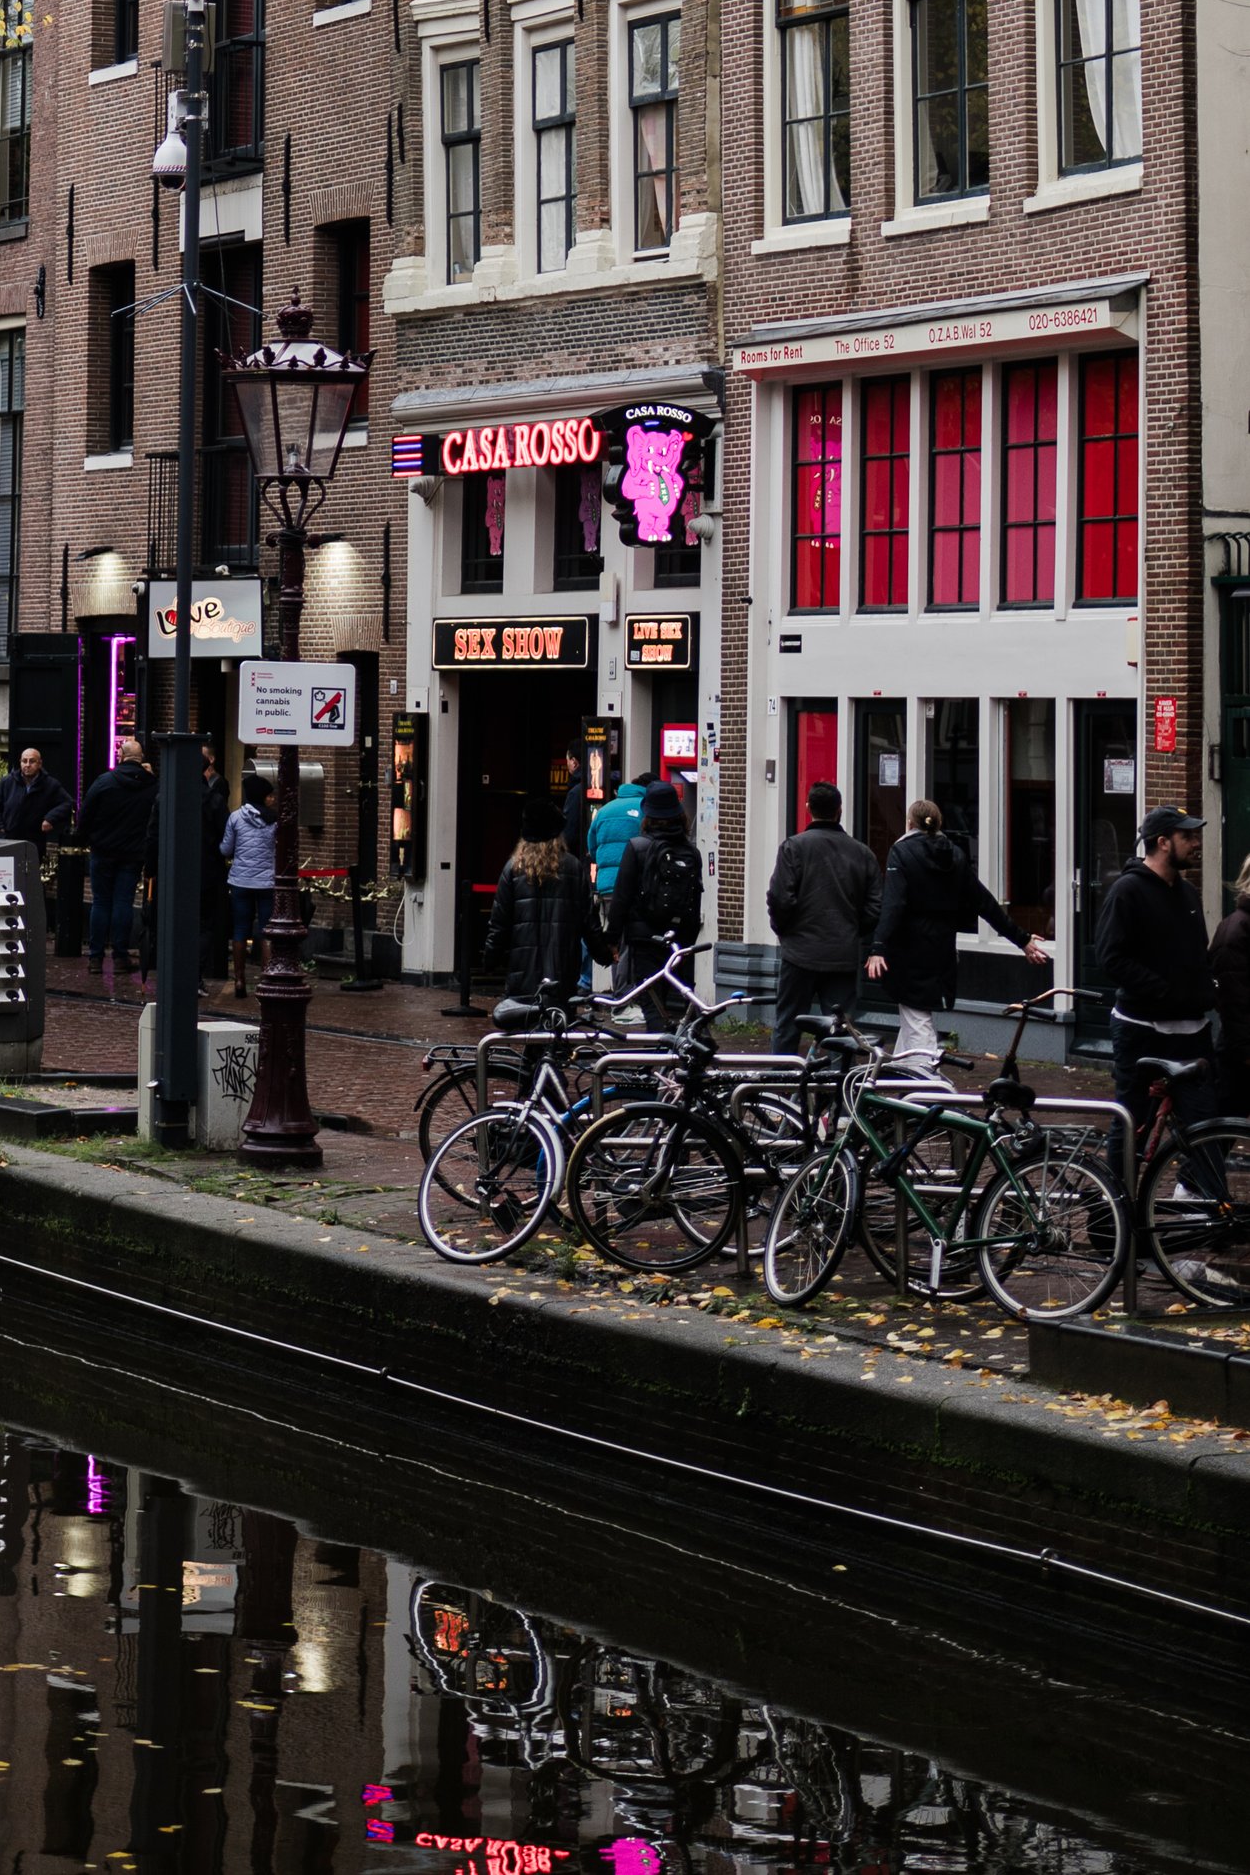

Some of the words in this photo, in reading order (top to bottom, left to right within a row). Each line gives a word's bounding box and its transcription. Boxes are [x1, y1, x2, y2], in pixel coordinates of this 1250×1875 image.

[740, 350, 768, 365] Rooms
[769, 347, 782, 362] for
[783, 345, 803, 361] Rent
[834, 340, 850, 355] The
[853, 337, 881, 353] Office
[883, 334, 896, 349] 52
[928, 324, 977, 344] O.Z.A.B.Wal
[979, 321, 992, 338] 52
[1028, 307, 1098, 331] 020-6386421
[624, 405, 655, 421] CASA
[655, 405, 693, 424] ROSSO
[441, 425, 512, 475] CASA
[513, 417, 601, 468] ROSSO
[632, 622, 659, 640] LIVE
[659, 621, 683, 640] SEX
[453, 627, 497, 661] SEX
[501, 626, 564, 660] SHOW
[640, 644, 674, 663] SHOW
[256, 686, 268, 694] No
[269, 686, 302, 697] smoking
[255, 697, 291, 706] cannabis
[255, 707, 263, 716] in
[264, 708, 291, 718] public.
